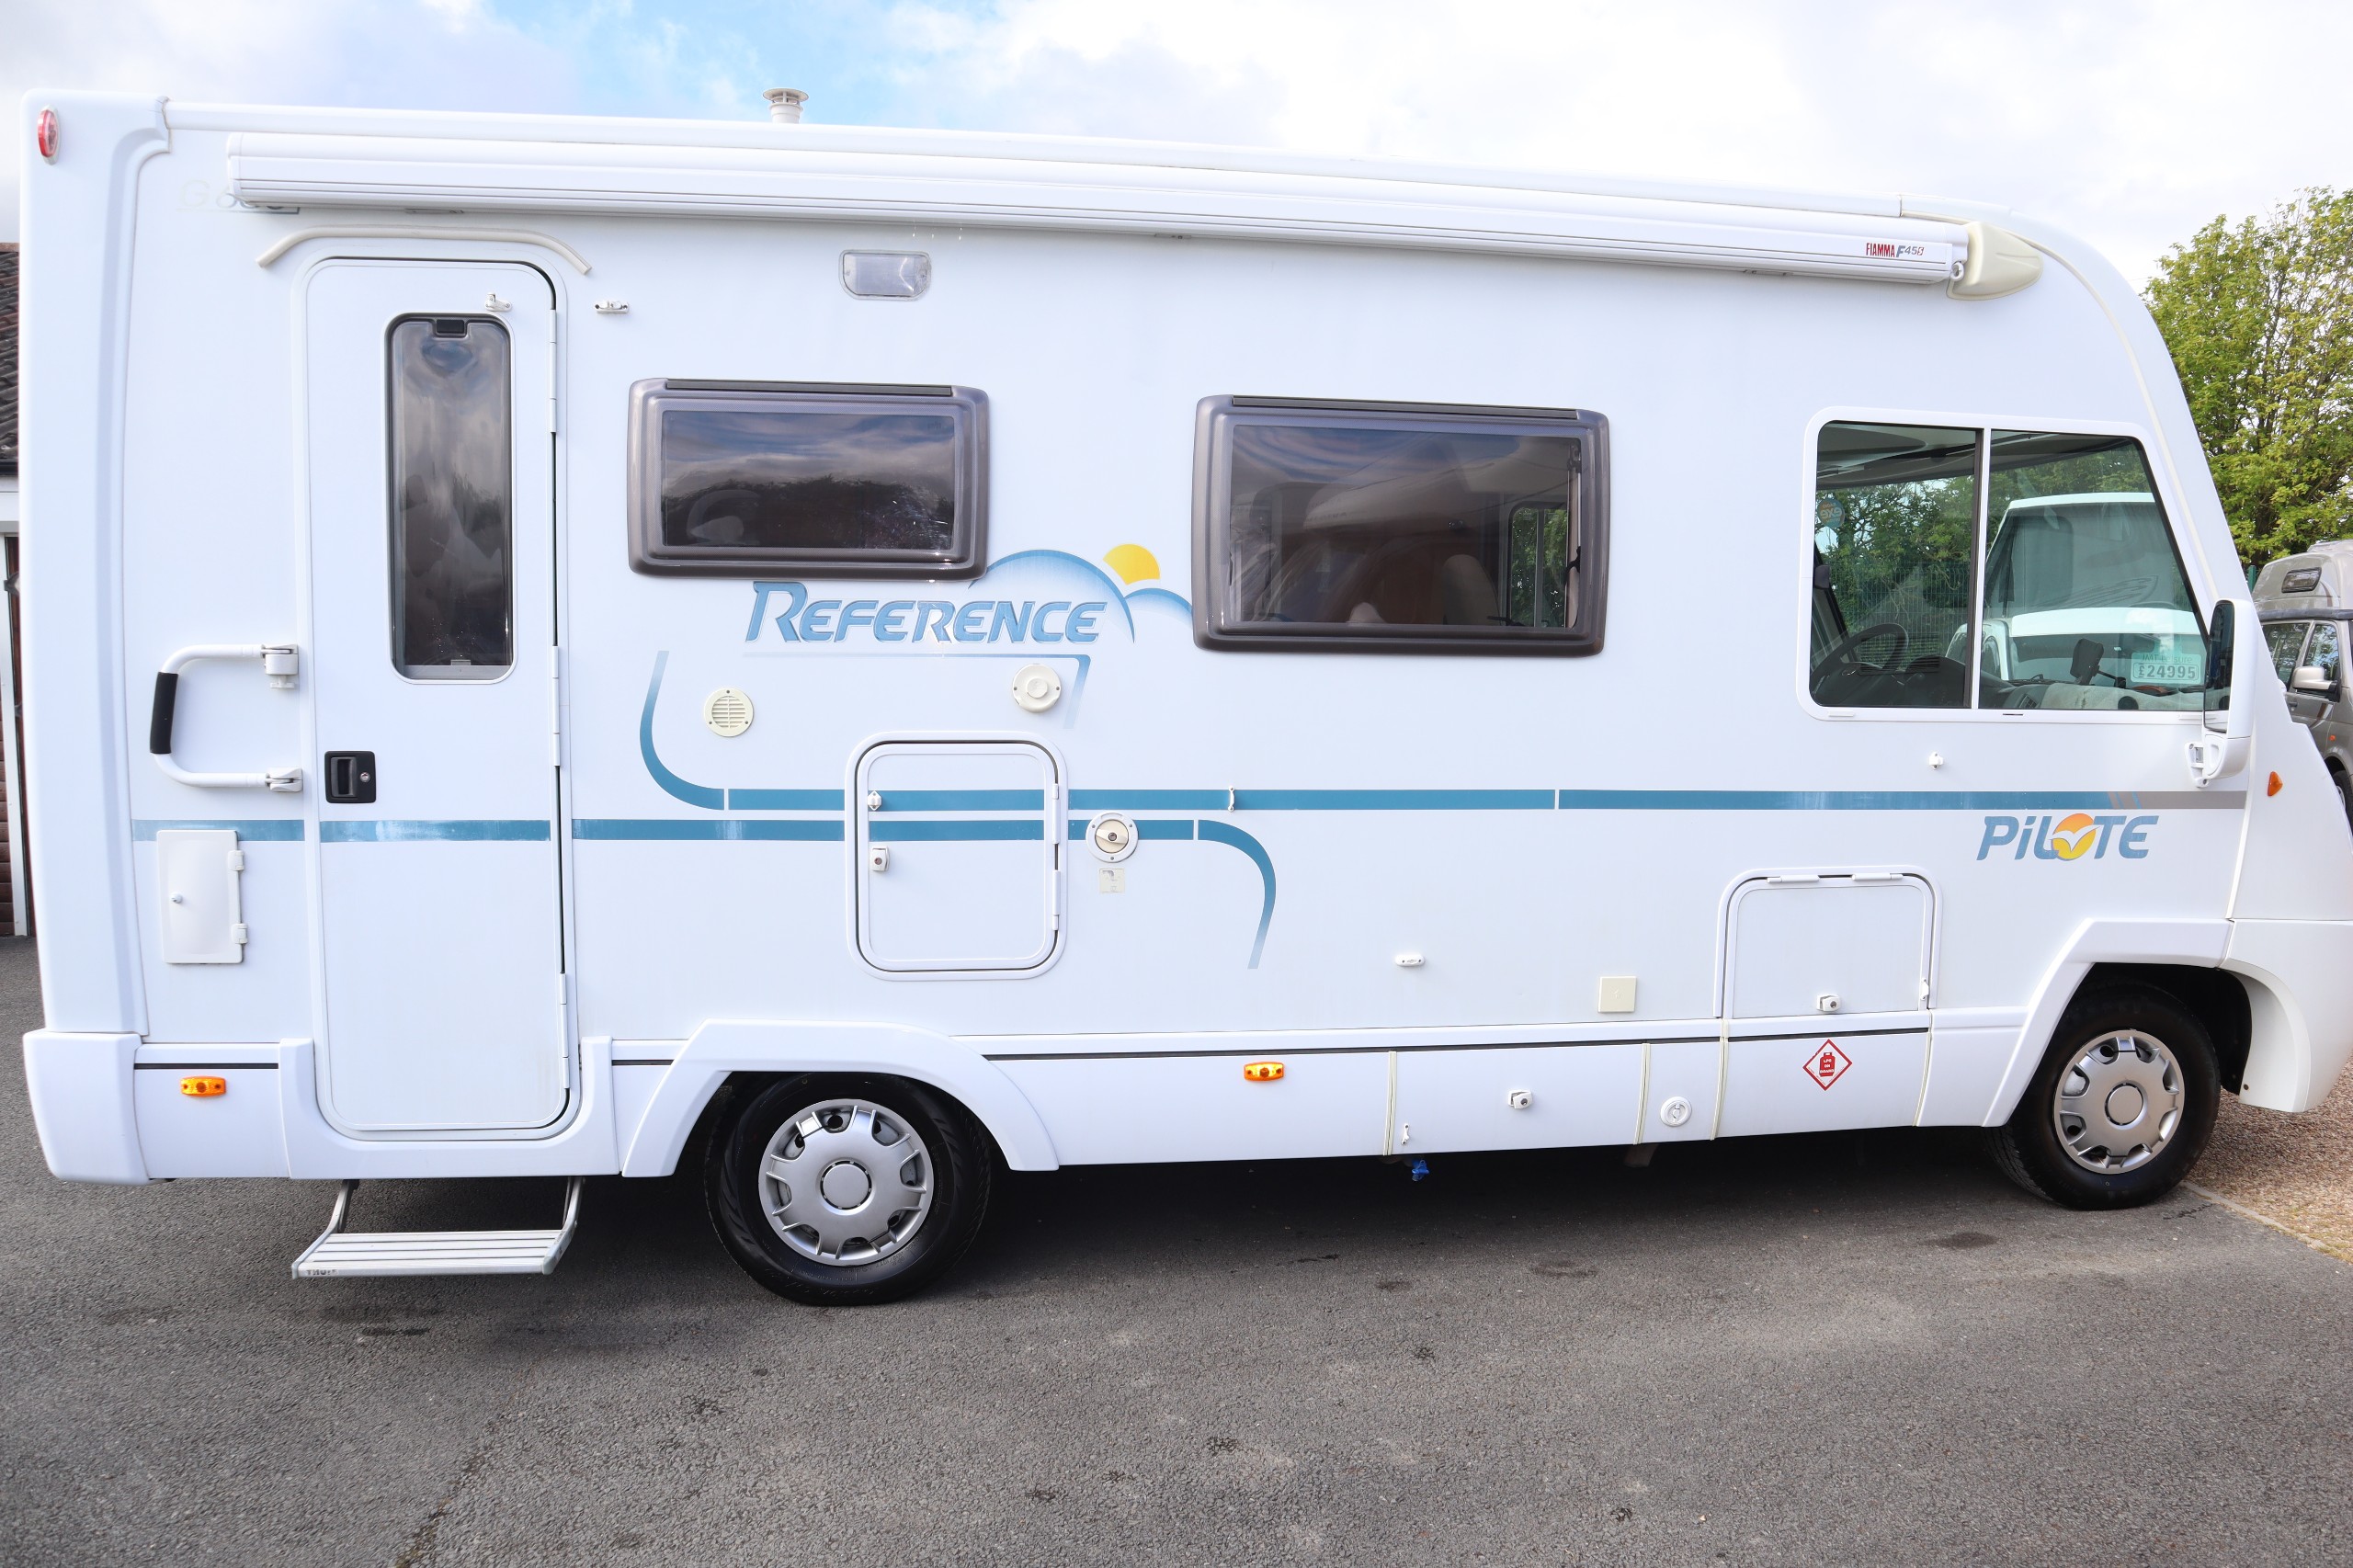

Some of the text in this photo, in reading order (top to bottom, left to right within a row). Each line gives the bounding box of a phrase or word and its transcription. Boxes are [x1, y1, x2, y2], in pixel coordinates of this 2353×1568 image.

[1866, 242, 1895, 257] FIAMMA
[745, 581, 1108, 643] REFERENCE
[2138, 664, 2196, 679] £24995
